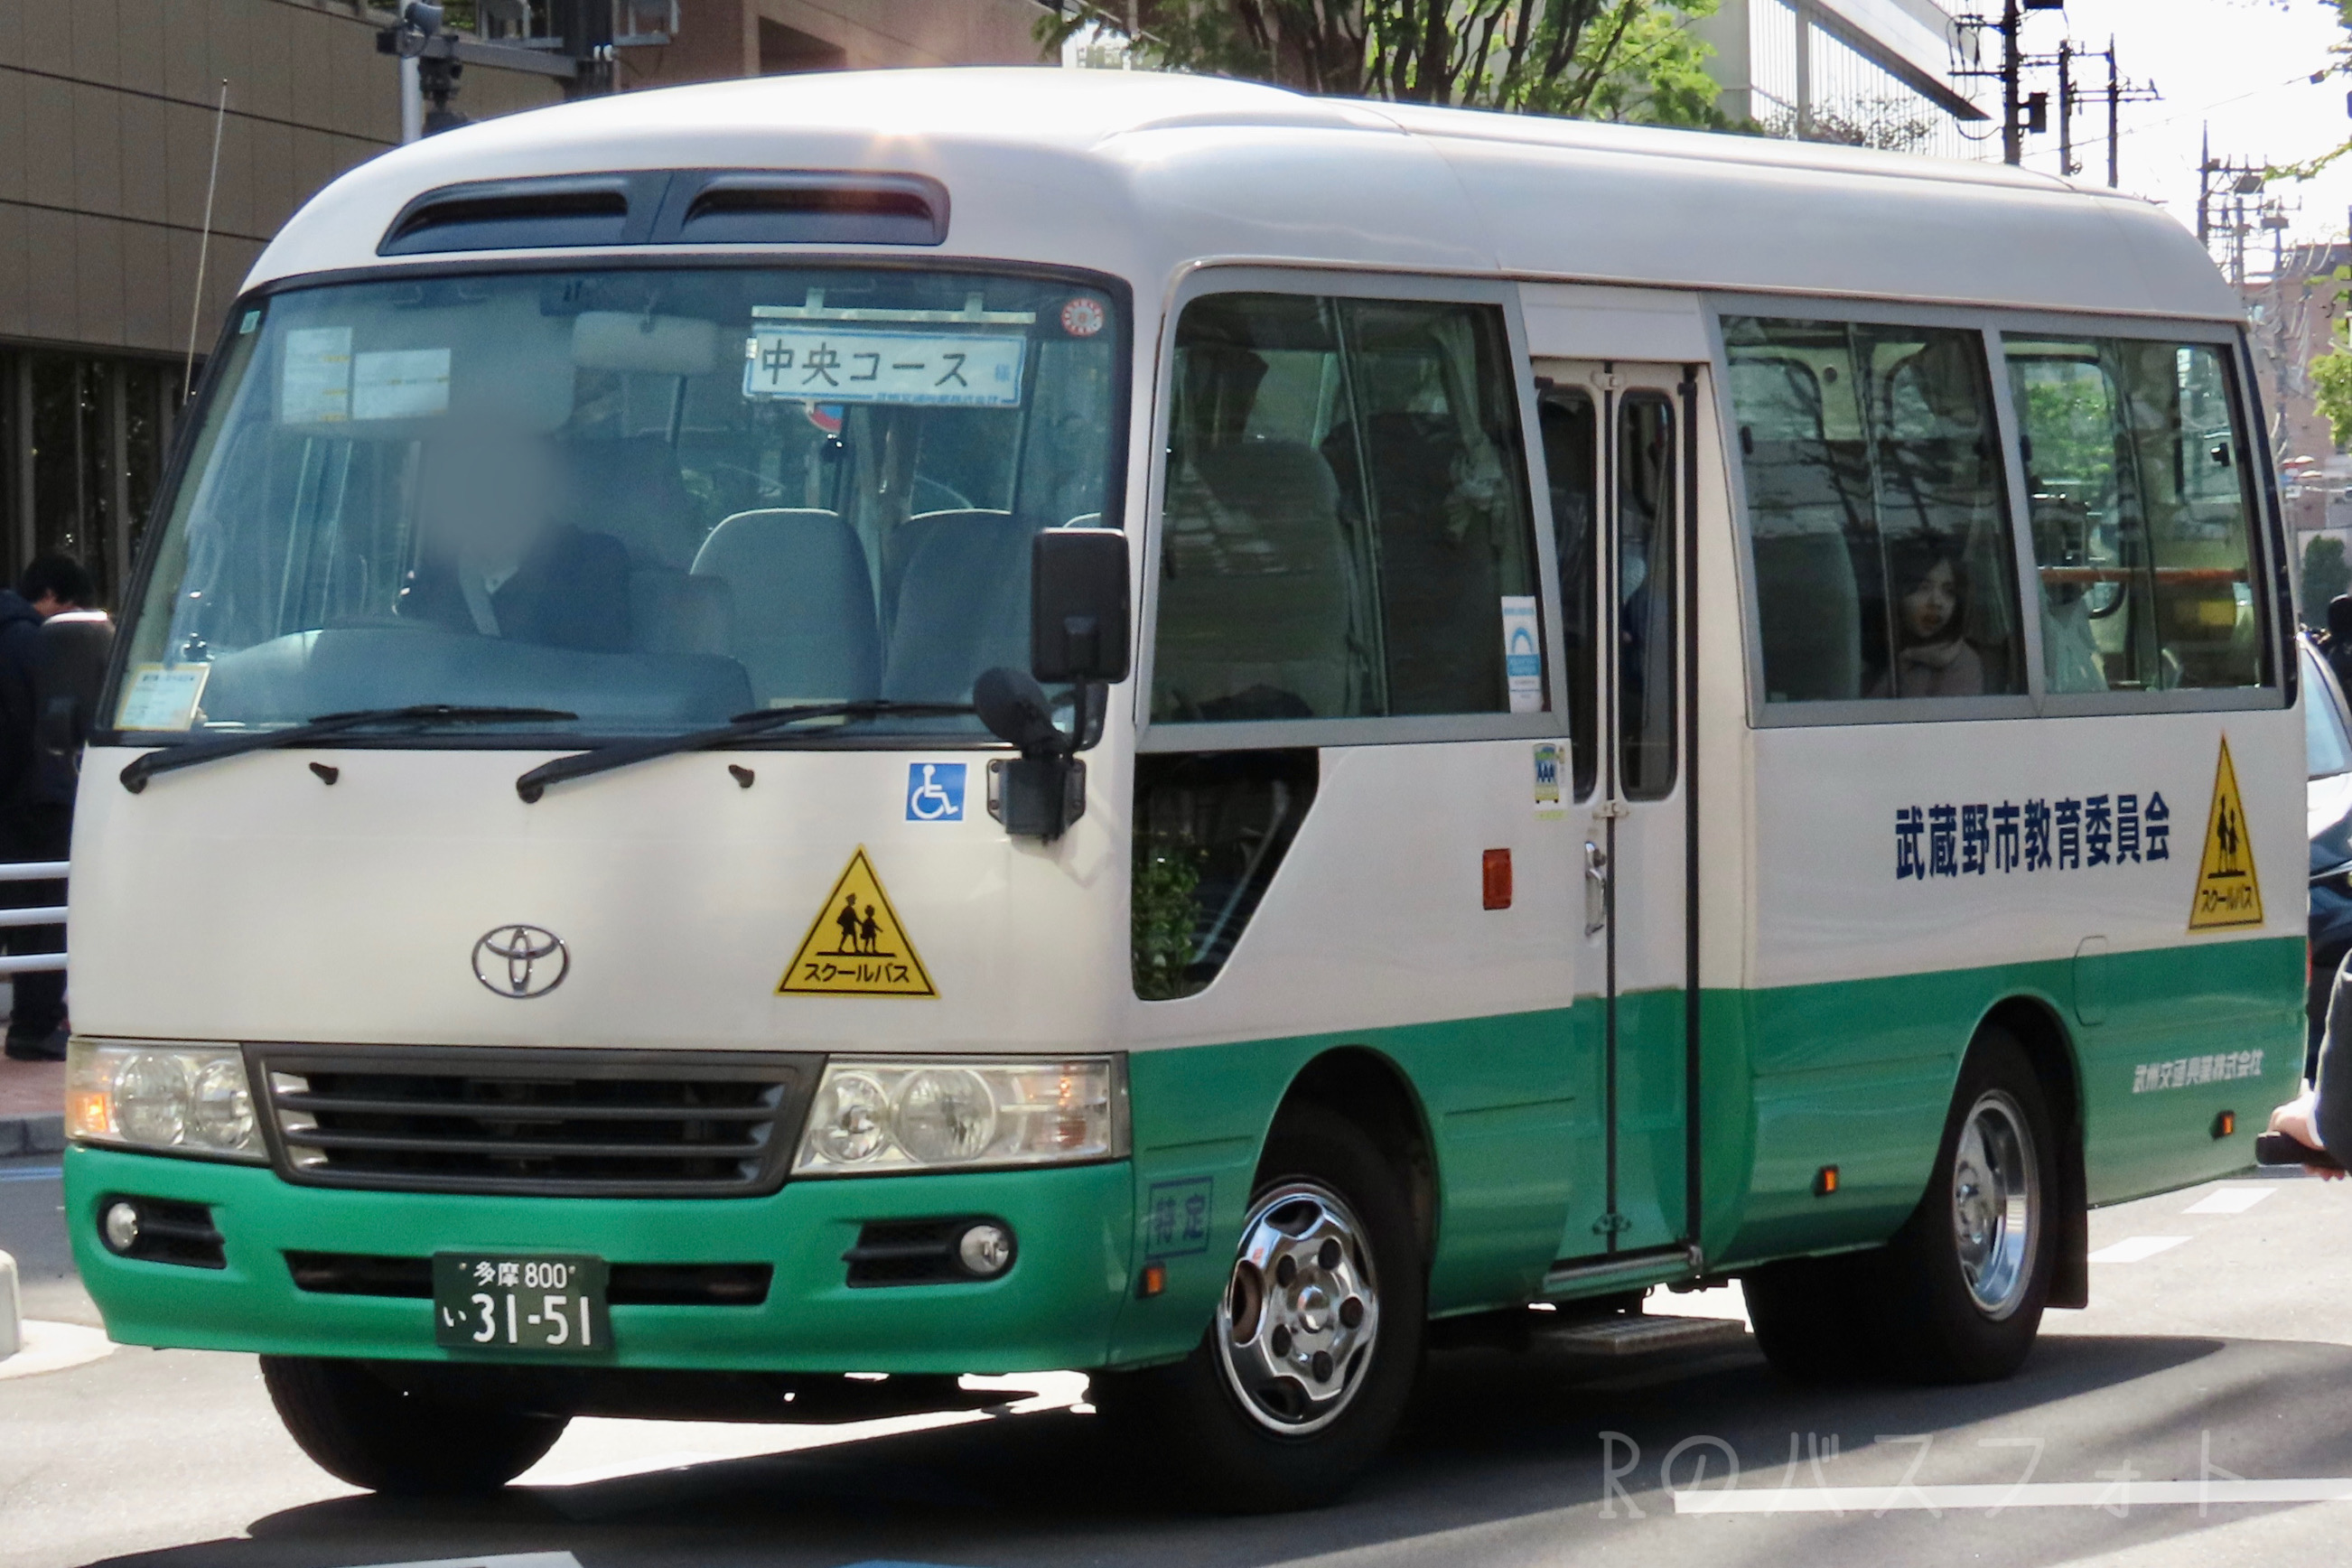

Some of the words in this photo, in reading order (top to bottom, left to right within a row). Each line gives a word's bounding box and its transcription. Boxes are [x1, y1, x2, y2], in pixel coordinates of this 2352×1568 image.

[761, 338, 968, 387] 中央コース
[1895, 790, 2170, 881] 武蔵野市教育委員会
[2200, 884, 2254, 913] スクールバス
[804, 963, 910, 984] スクールバス
[472, 1261, 520, 1287] 多摩
[524, 1262, 568, 1289] 800
[443, 1305, 467, 1328] い
[471, 1293, 591, 1346] 31-51
